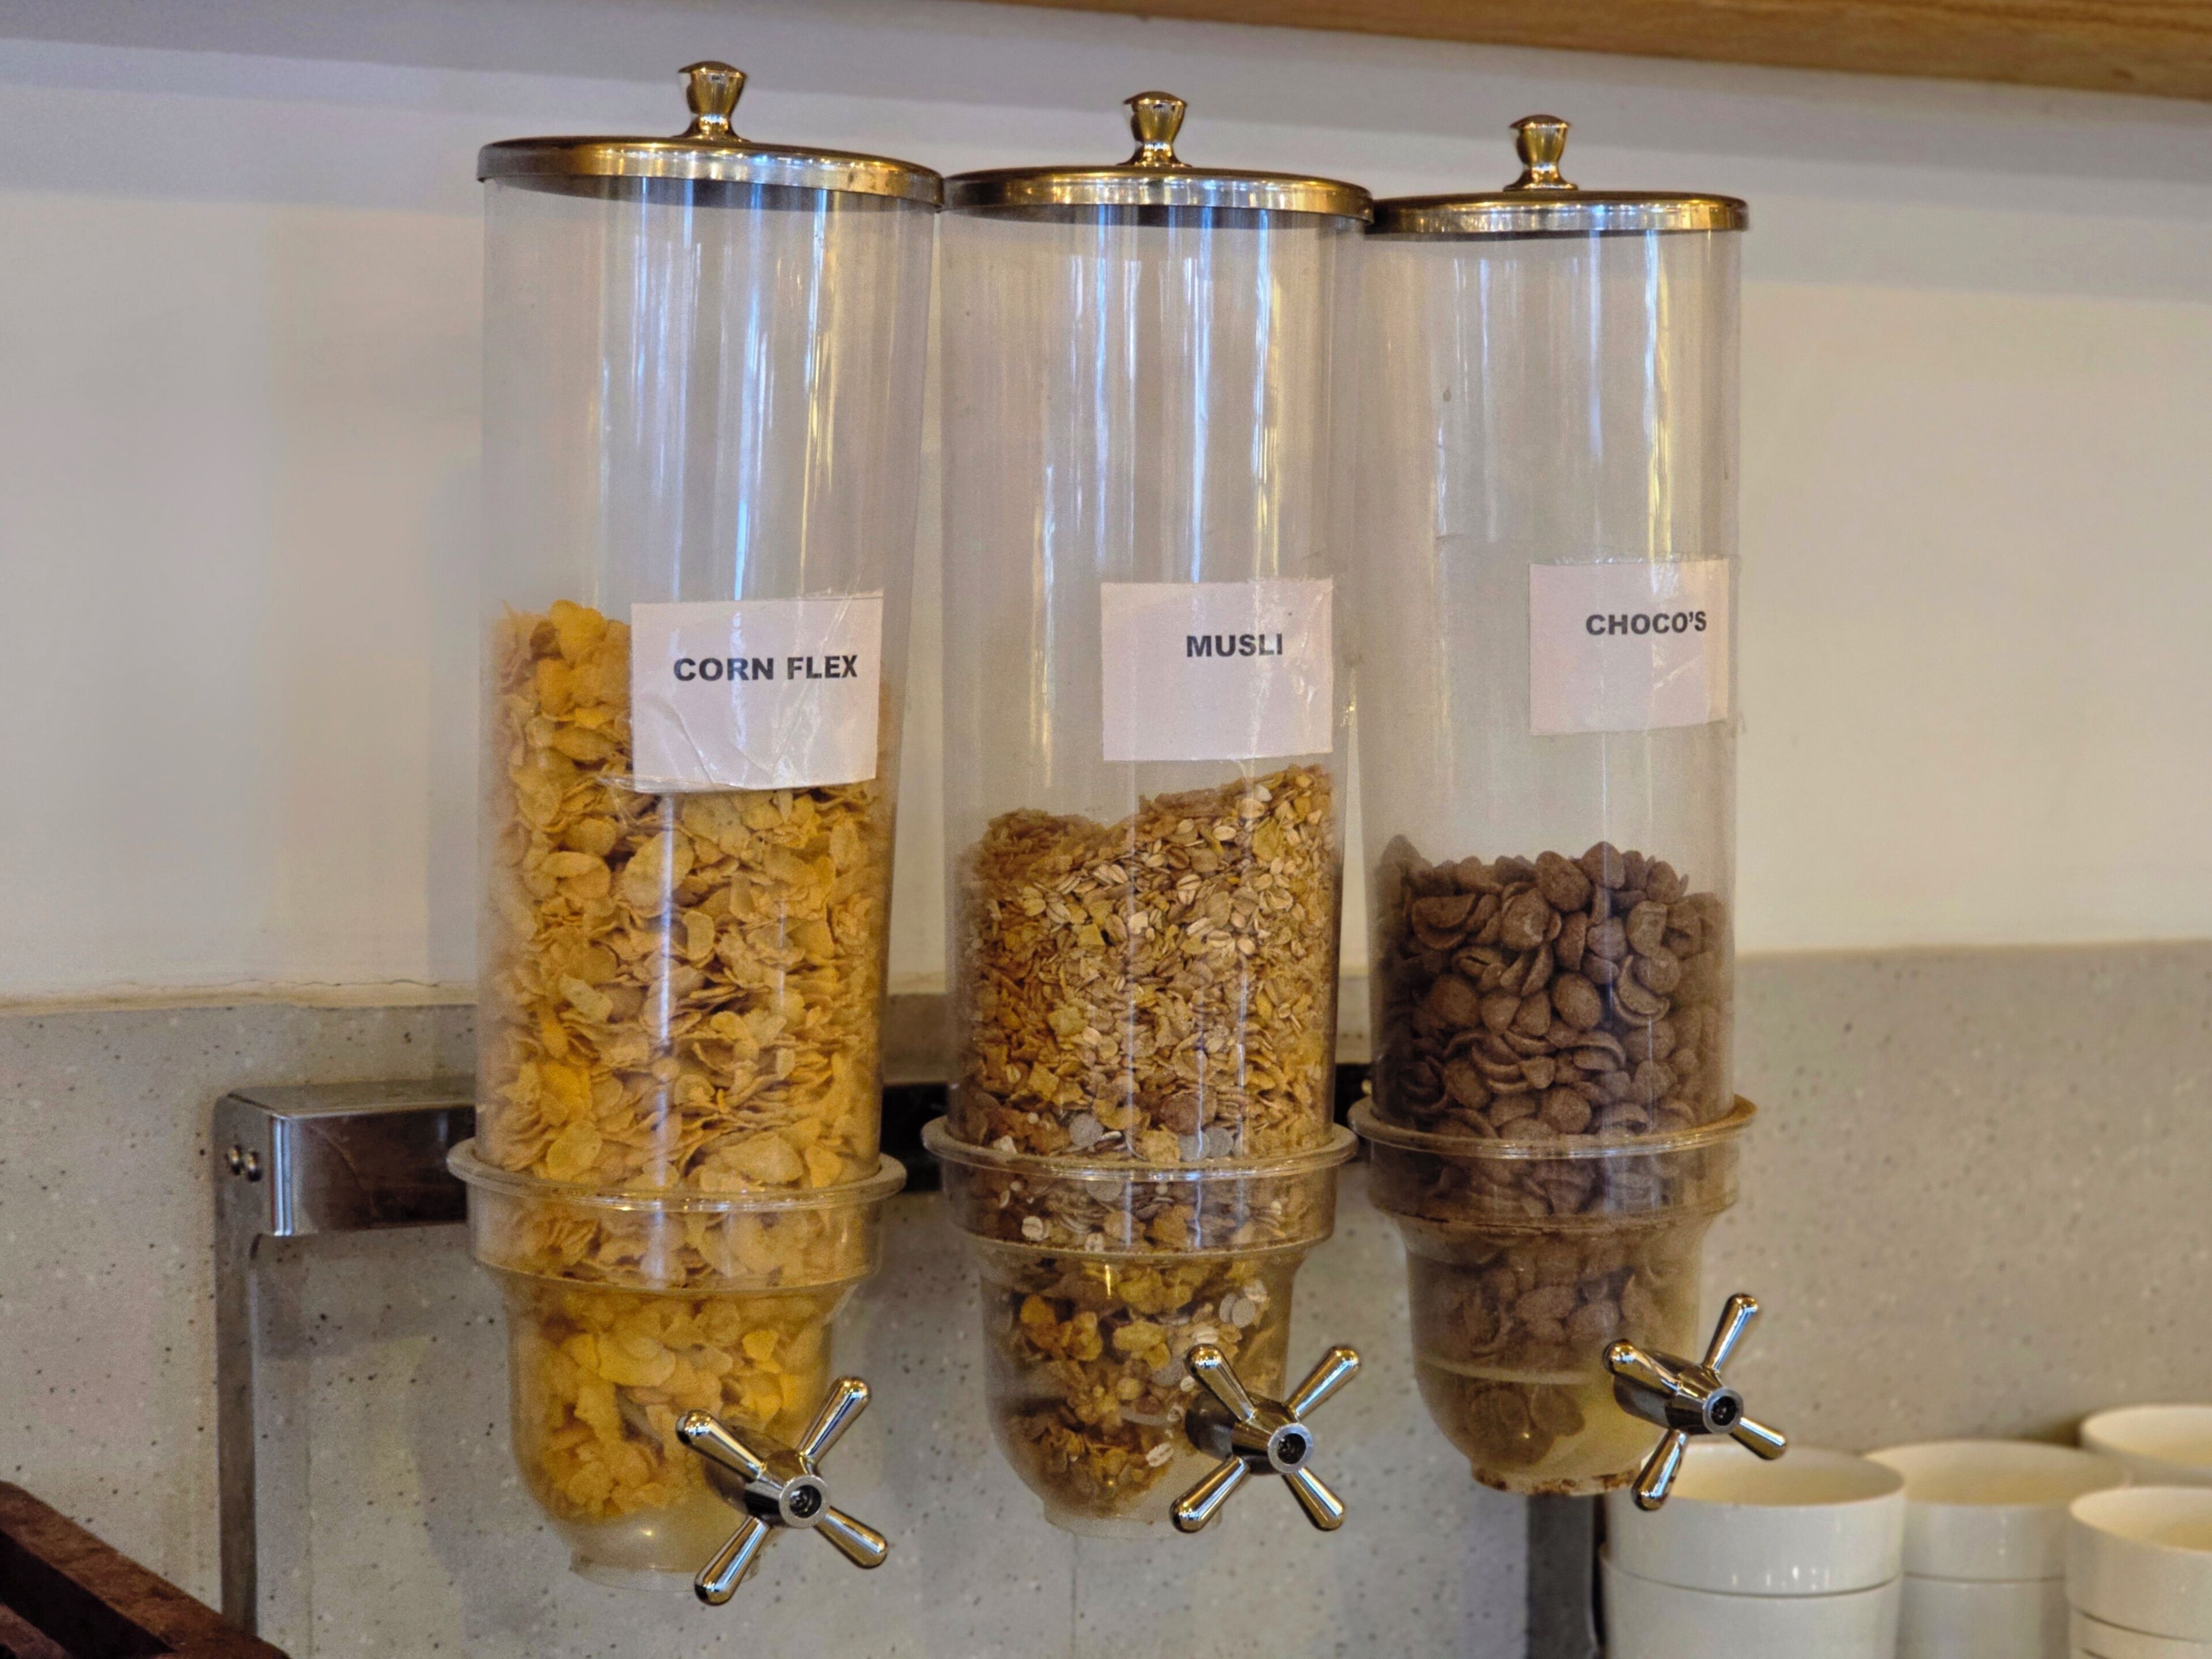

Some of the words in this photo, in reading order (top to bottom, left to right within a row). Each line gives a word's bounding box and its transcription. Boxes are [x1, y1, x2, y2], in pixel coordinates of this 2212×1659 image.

[1585, 611, 1707, 635] CHOCO'S
[1186, 633, 1283, 657] MUSLI
[673, 657, 774, 681] CORN
[787, 654, 858, 680] FLEX
